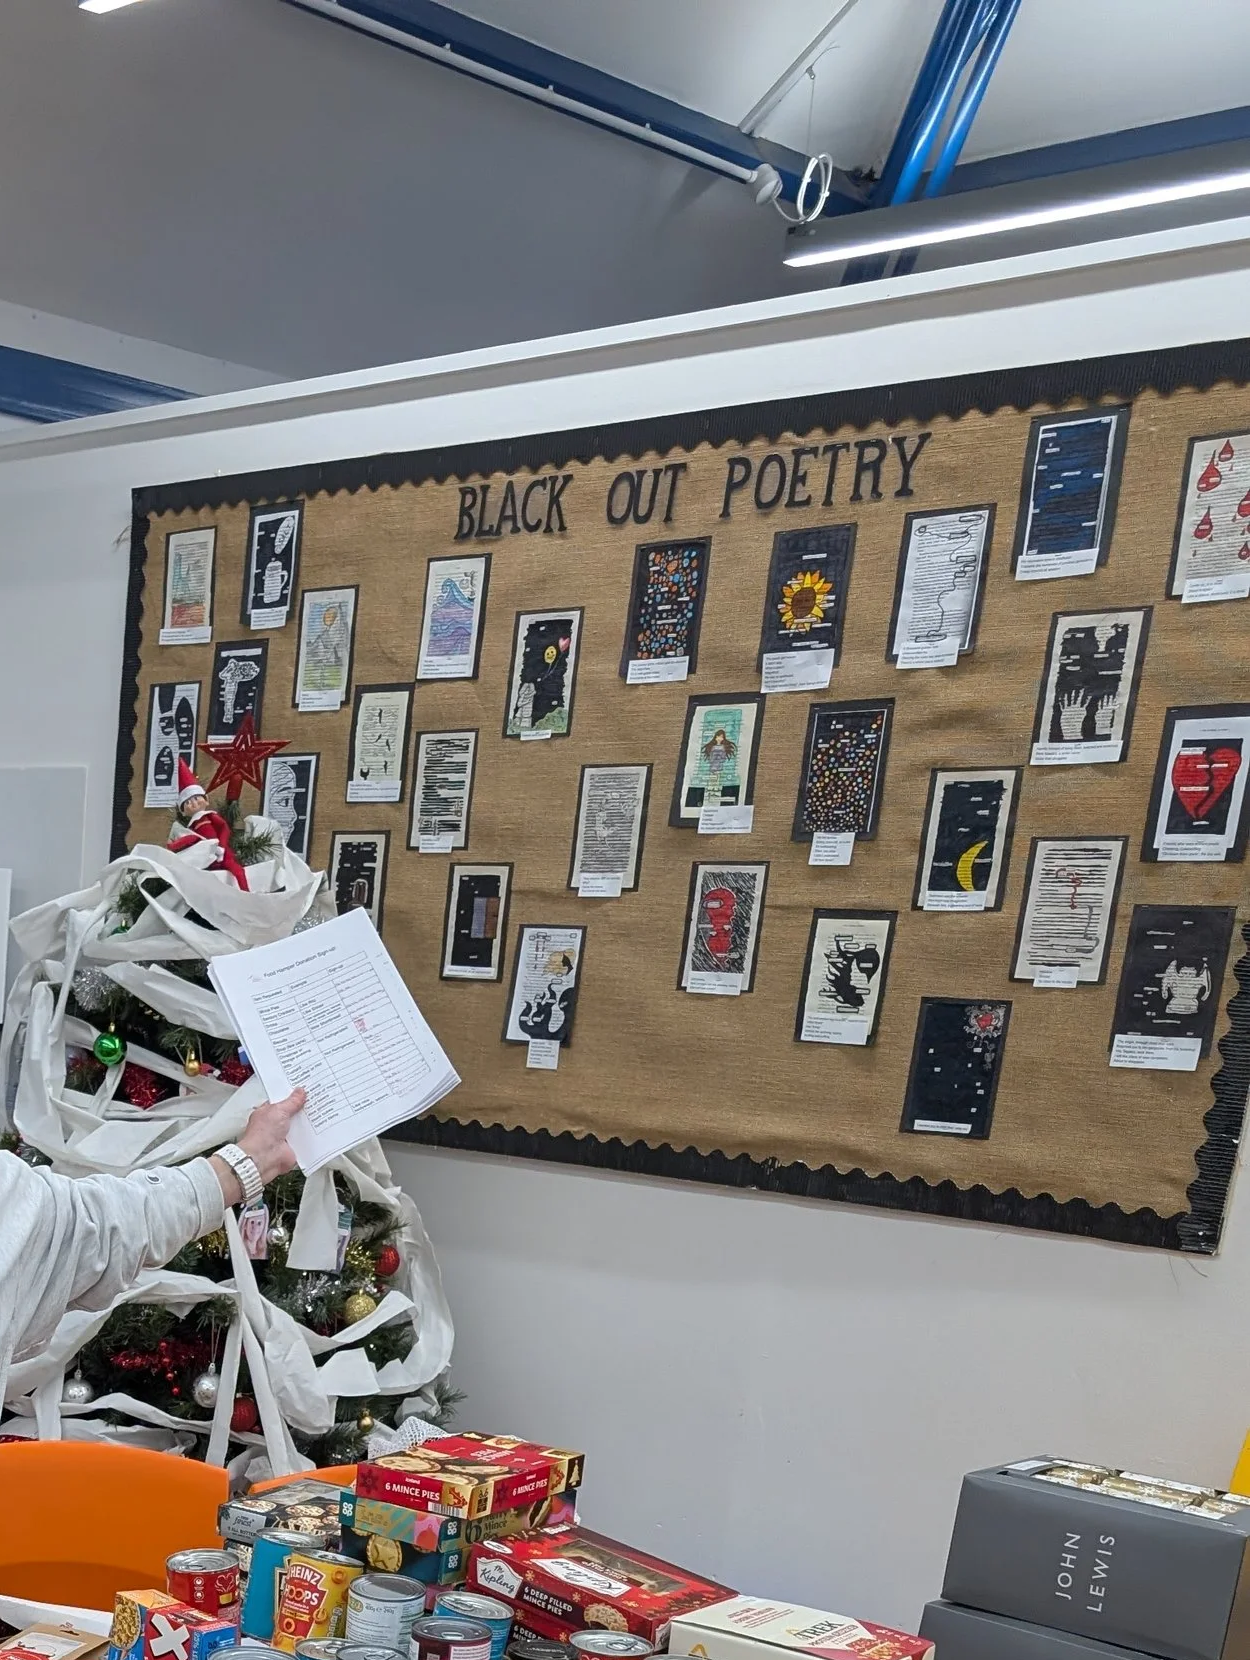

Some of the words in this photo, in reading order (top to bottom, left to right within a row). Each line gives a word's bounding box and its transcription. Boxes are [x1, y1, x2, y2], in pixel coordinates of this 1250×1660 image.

[454, 474, 574, 540] BLACK
[606, 462, 688, 525] OUT
[719, 431, 933, 518] POETRY
[263, 969, 276, 979] Food
[296, 953, 317, 968] Donation
[385, 1482, 391, 1491] 6
[392, 1483, 421, 1497] MINCE
[422, 1488, 440, 1501] PIES
[512, 1488, 518, 1497] 6
[517, 1483, 535, 1496] MINCE
[535, 1478, 548, 1491] PIES
[233, 1516, 253, 1528] finest
[483, 1519, 508, 1532] Mince
[290, 1563, 322, 1586] HEINZ
[1054, 1532, 1081, 1601] JOHN
[1086, 1533, 1116, 1613] LEWIS
[479, 1567, 516, 1594] Kipling
[284, 1584, 320, 1606] HOOPS
[523, 1594, 546, 1608] MINCE
[546, 1604, 563, 1617] PIES
[529, 1588, 549, 1601] DEEP
[549, 1598, 573, 1613] FILLED
[513, 1625, 519, 1633] 6
[519, 1627, 538, 1640] DEEP
[794, 1619, 844, 1641] TREK
